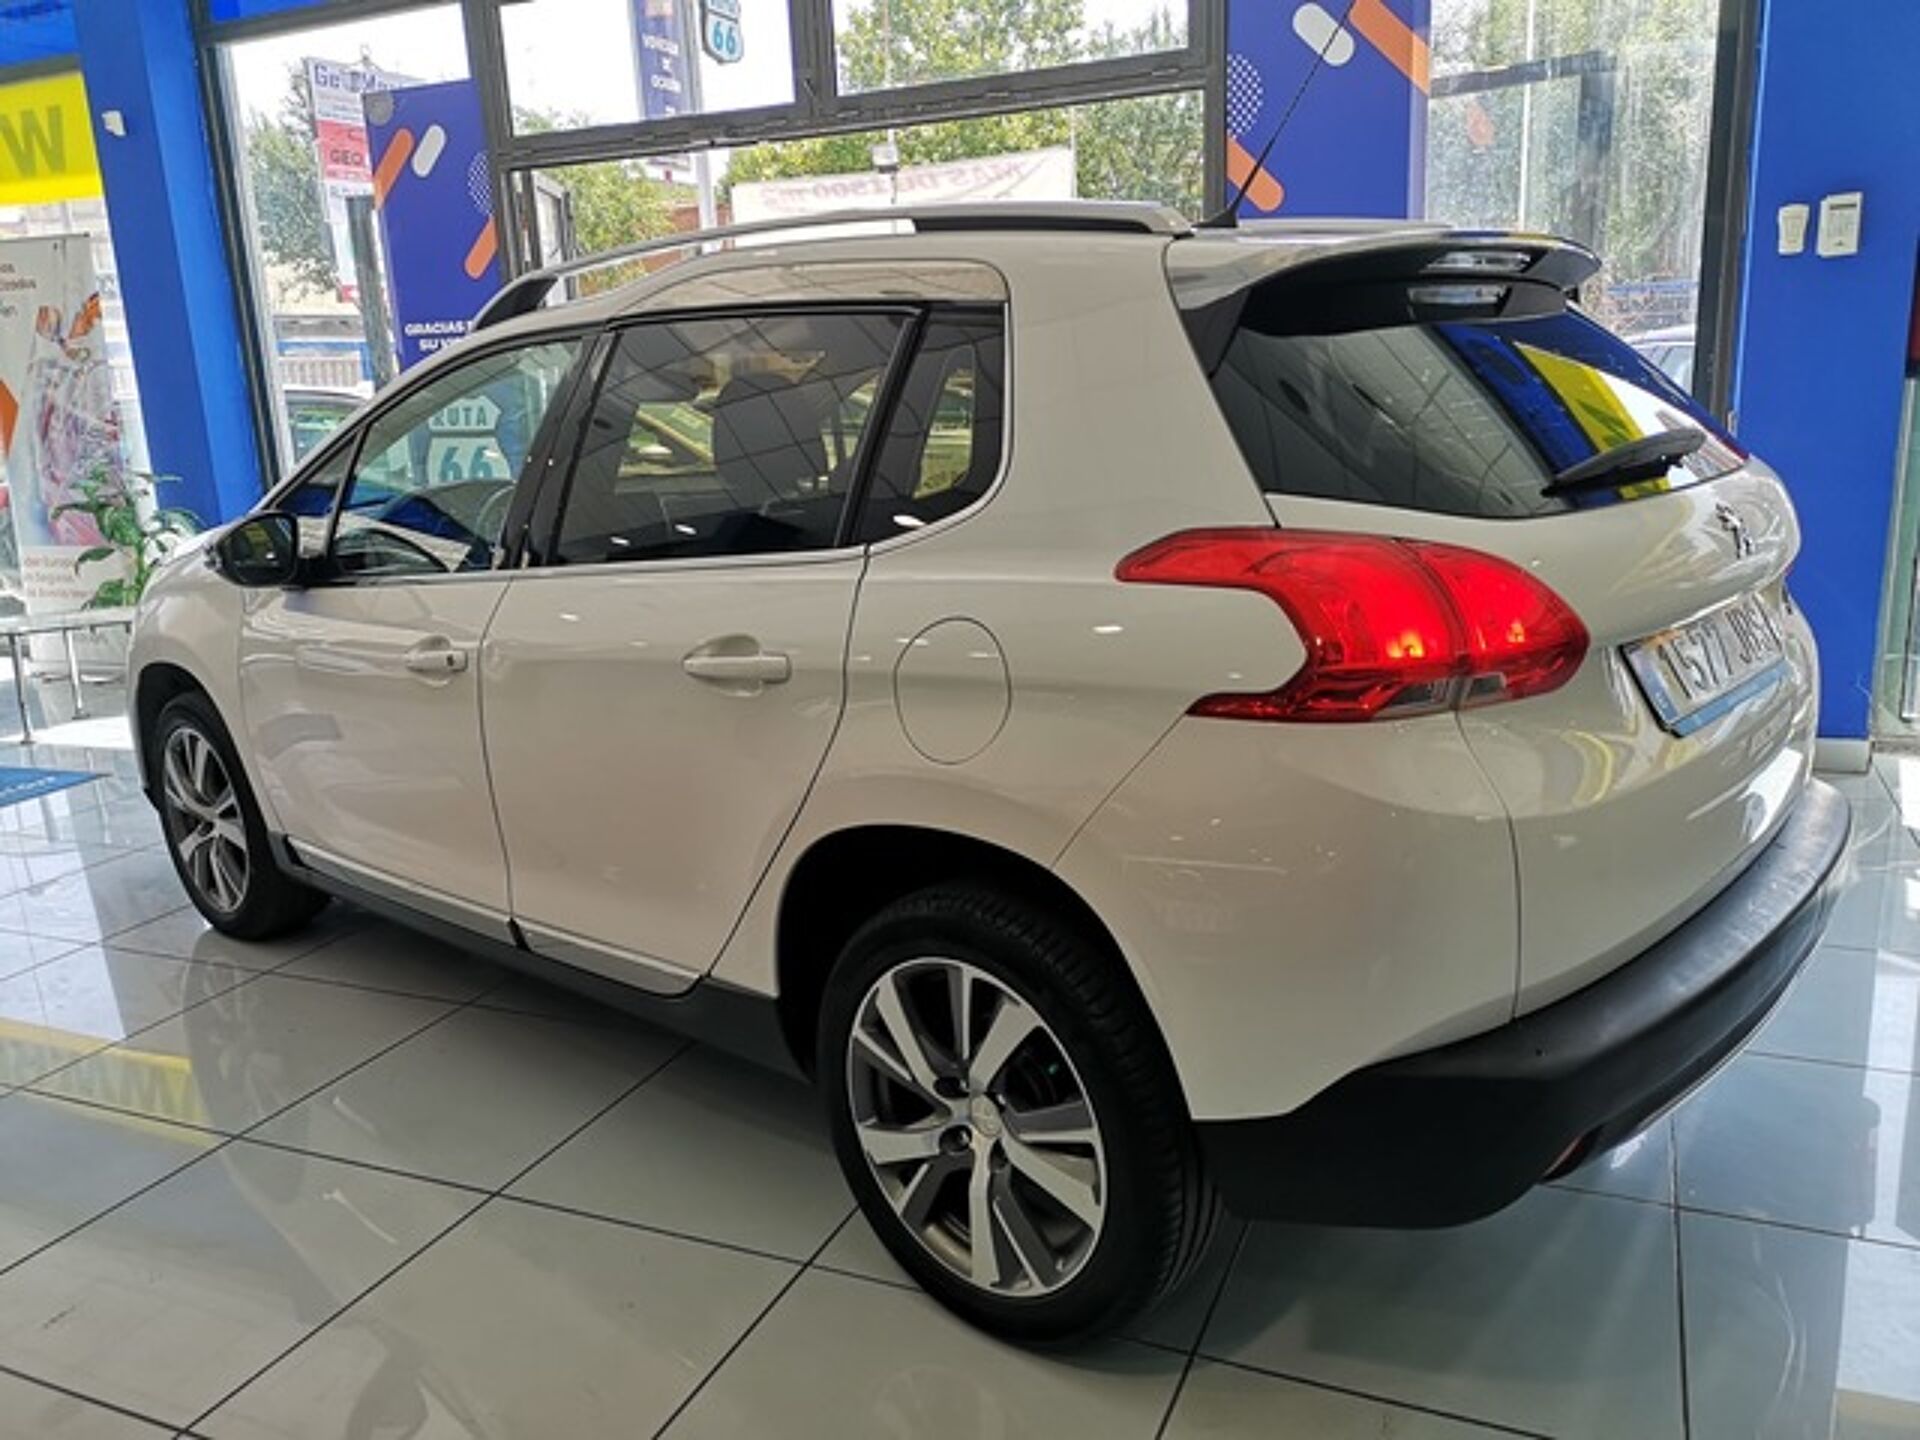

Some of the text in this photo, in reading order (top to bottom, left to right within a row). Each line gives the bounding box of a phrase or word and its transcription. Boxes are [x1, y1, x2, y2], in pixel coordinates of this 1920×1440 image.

[713, 20, 736, 55] 66
[404, 320, 465, 337] GRACIAS
[439, 446, 494, 481] 66
[1657, 620, 1734, 700] 1577
